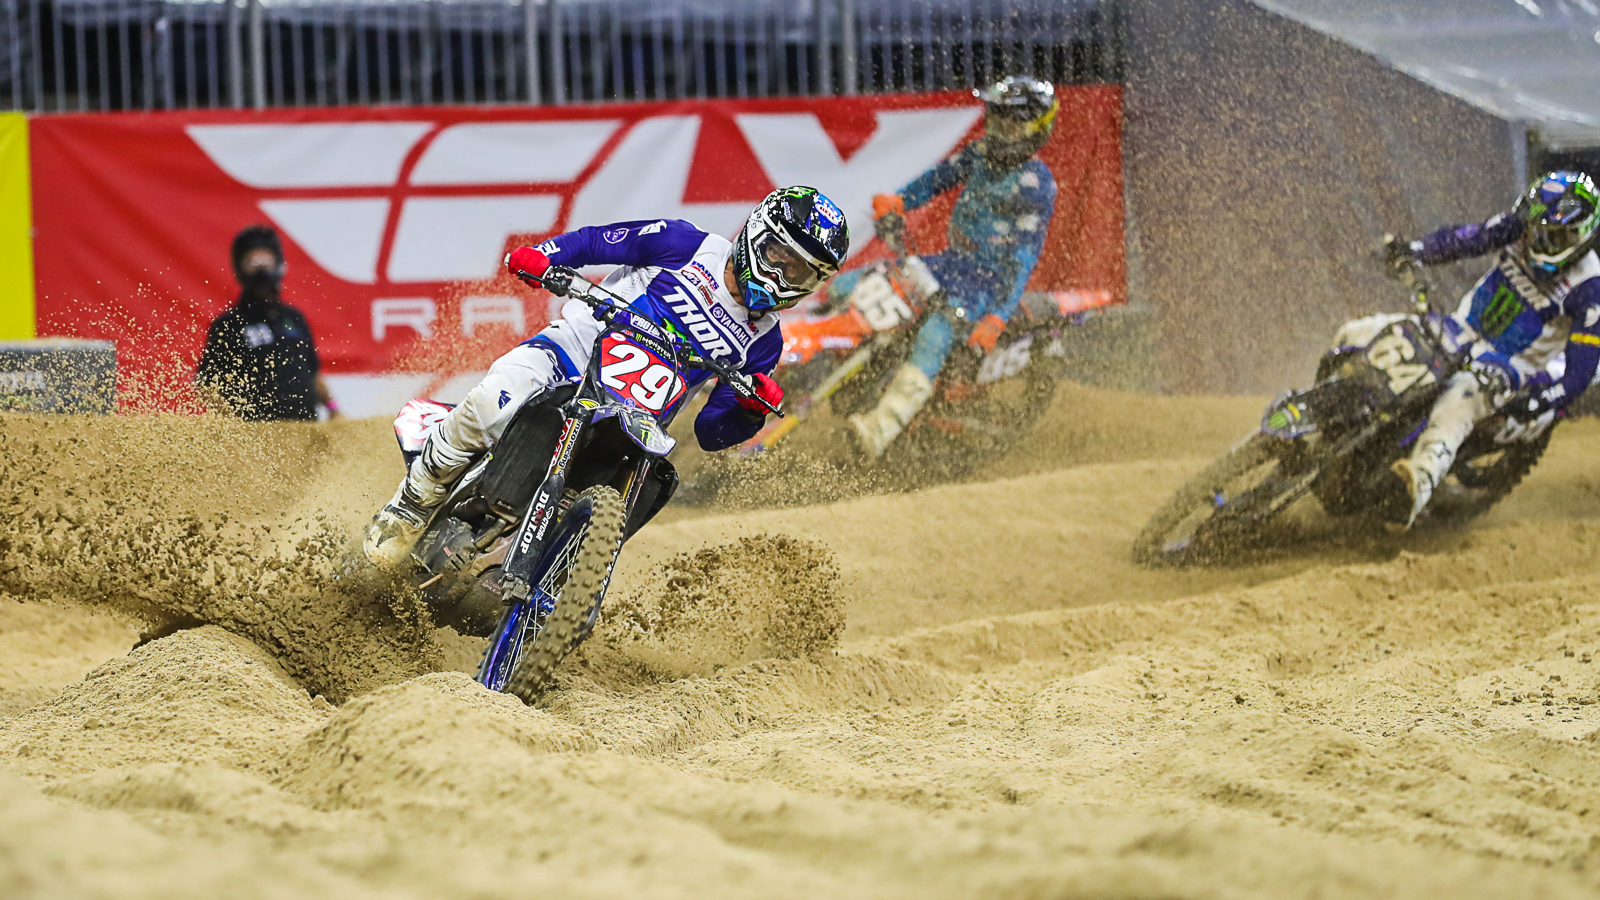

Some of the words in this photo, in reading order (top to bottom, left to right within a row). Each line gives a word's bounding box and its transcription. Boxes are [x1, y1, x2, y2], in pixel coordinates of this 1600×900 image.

[641, 336, 672, 360] MONSTER
[661, 285, 733, 361] THOR
[720, 314, 750, 347] YAMAHA
[600, 343, 683, 411] 29
[1367, 324, 1436, 396] 64
